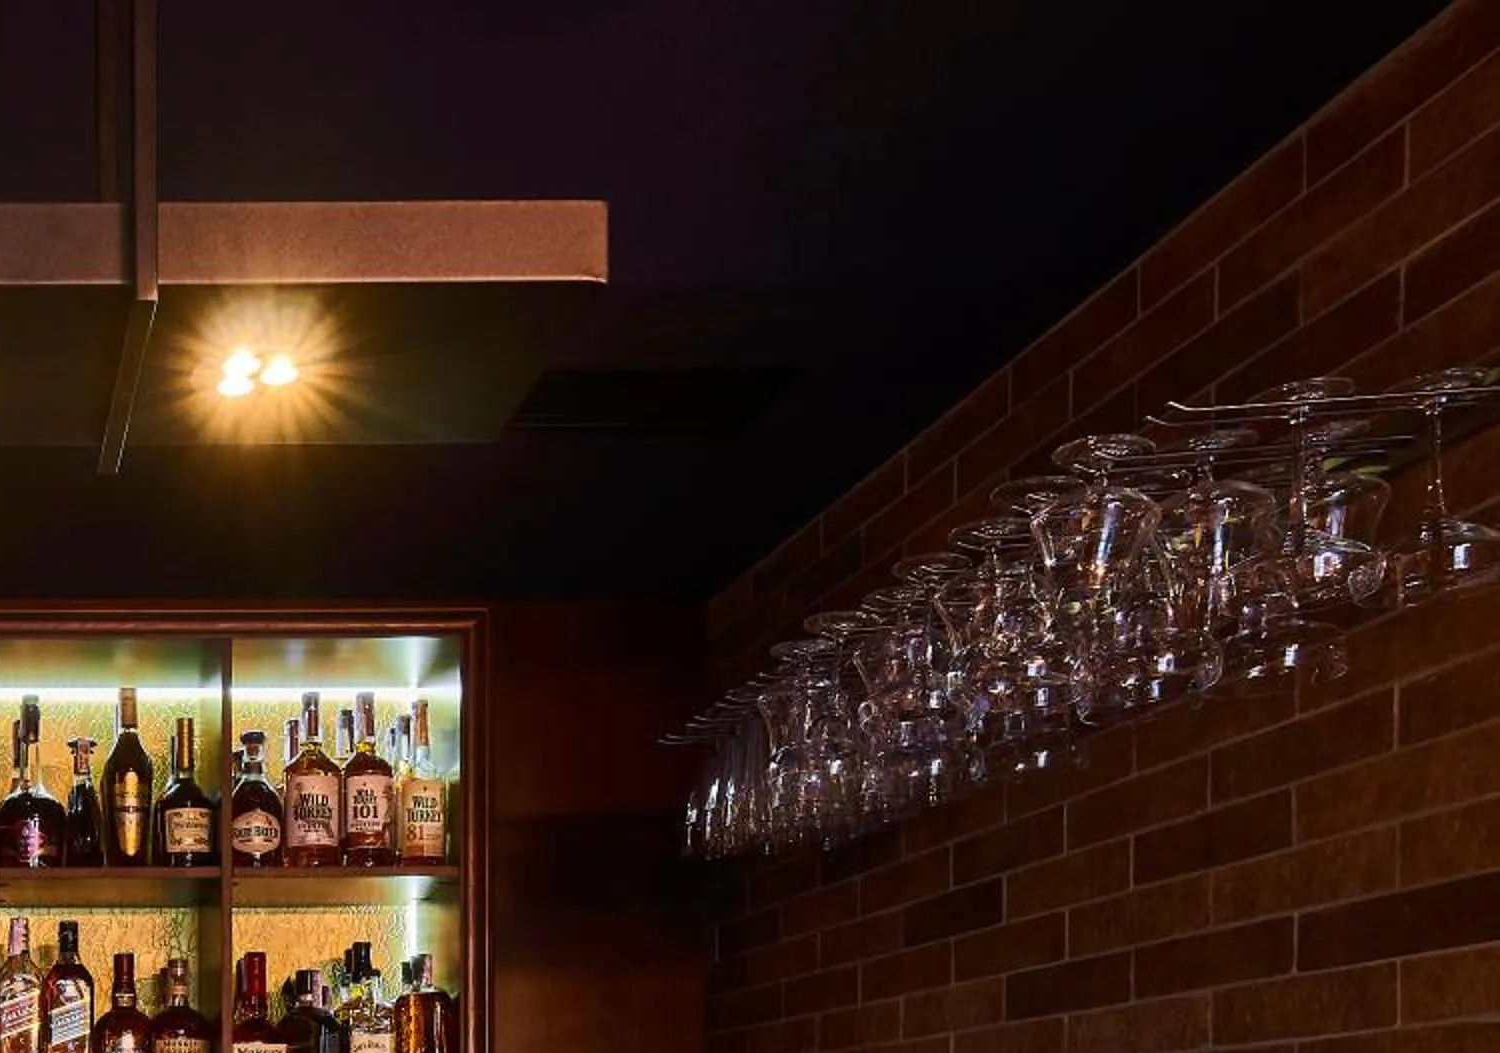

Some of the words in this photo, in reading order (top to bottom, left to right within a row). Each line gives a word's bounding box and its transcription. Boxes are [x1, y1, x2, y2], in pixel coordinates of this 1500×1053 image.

[300, 793, 329, 806] WILD
[413, 796, 437, 809] WILD
[353, 805, 378, 819] 101
[406, 808, 442, 822] TURKEY
[406, 826, 425, 840] 81
